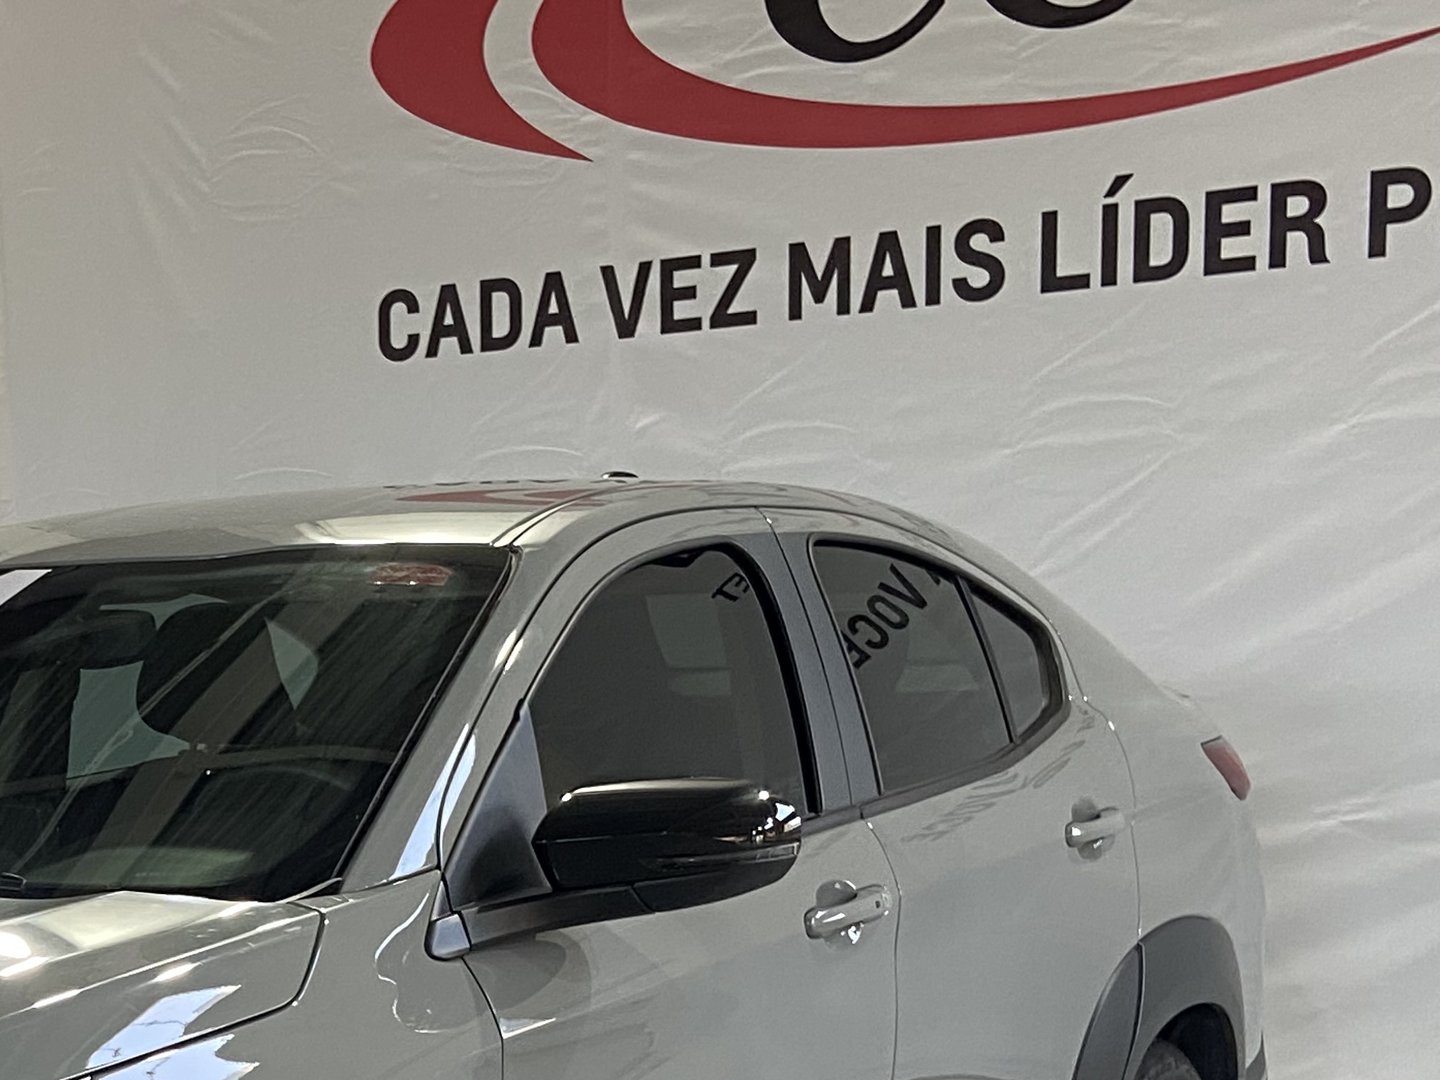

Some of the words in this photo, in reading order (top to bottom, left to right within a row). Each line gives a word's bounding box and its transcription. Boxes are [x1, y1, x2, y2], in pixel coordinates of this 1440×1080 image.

[377, 270, 579, 362] CADA
[600, 247, 758, 340] VEZ
[788, 217, 1006, 322] MAIS
[1039, 173, 1331, 294] LÍDER
